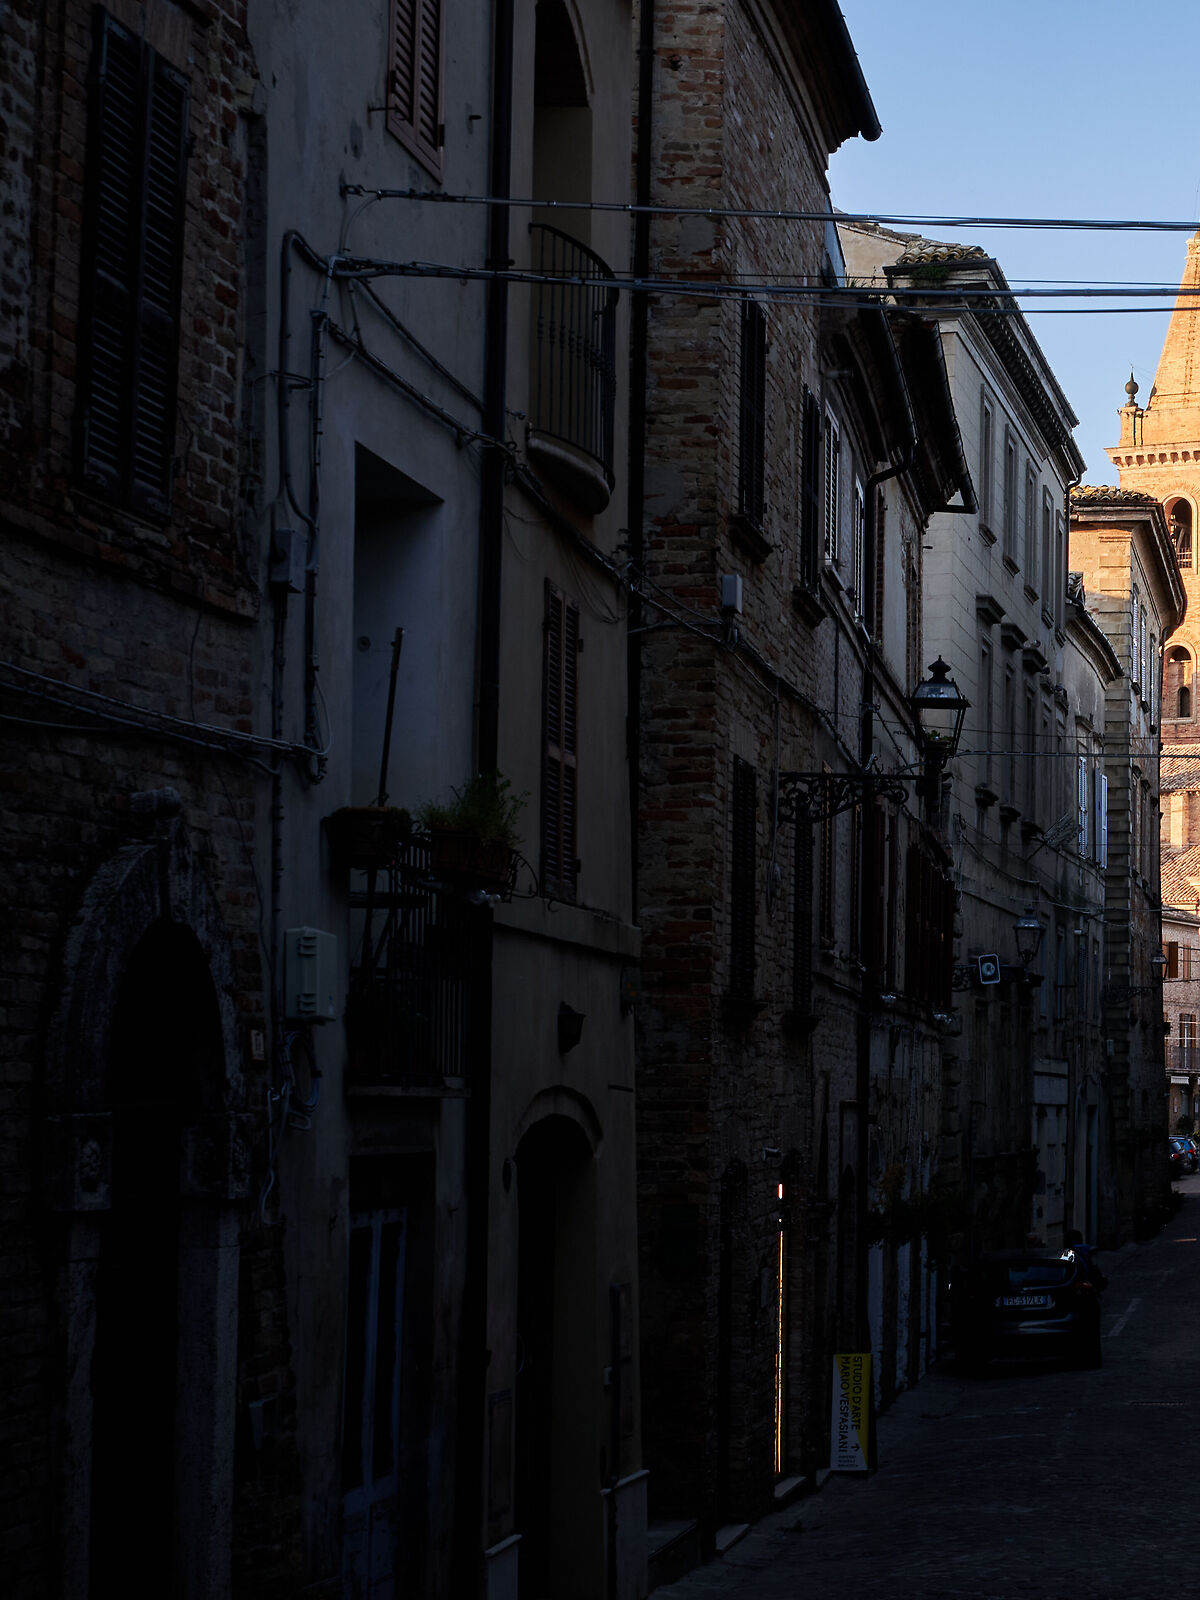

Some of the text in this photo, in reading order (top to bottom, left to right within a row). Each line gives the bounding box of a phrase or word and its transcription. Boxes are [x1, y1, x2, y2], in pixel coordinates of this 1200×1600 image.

[840, 1356, 851, 1390] MARIO
[851, 1356, 862, 1430] STUDIO D'ARTE
[838, 1391, 849, 1453] VESPASIANI
